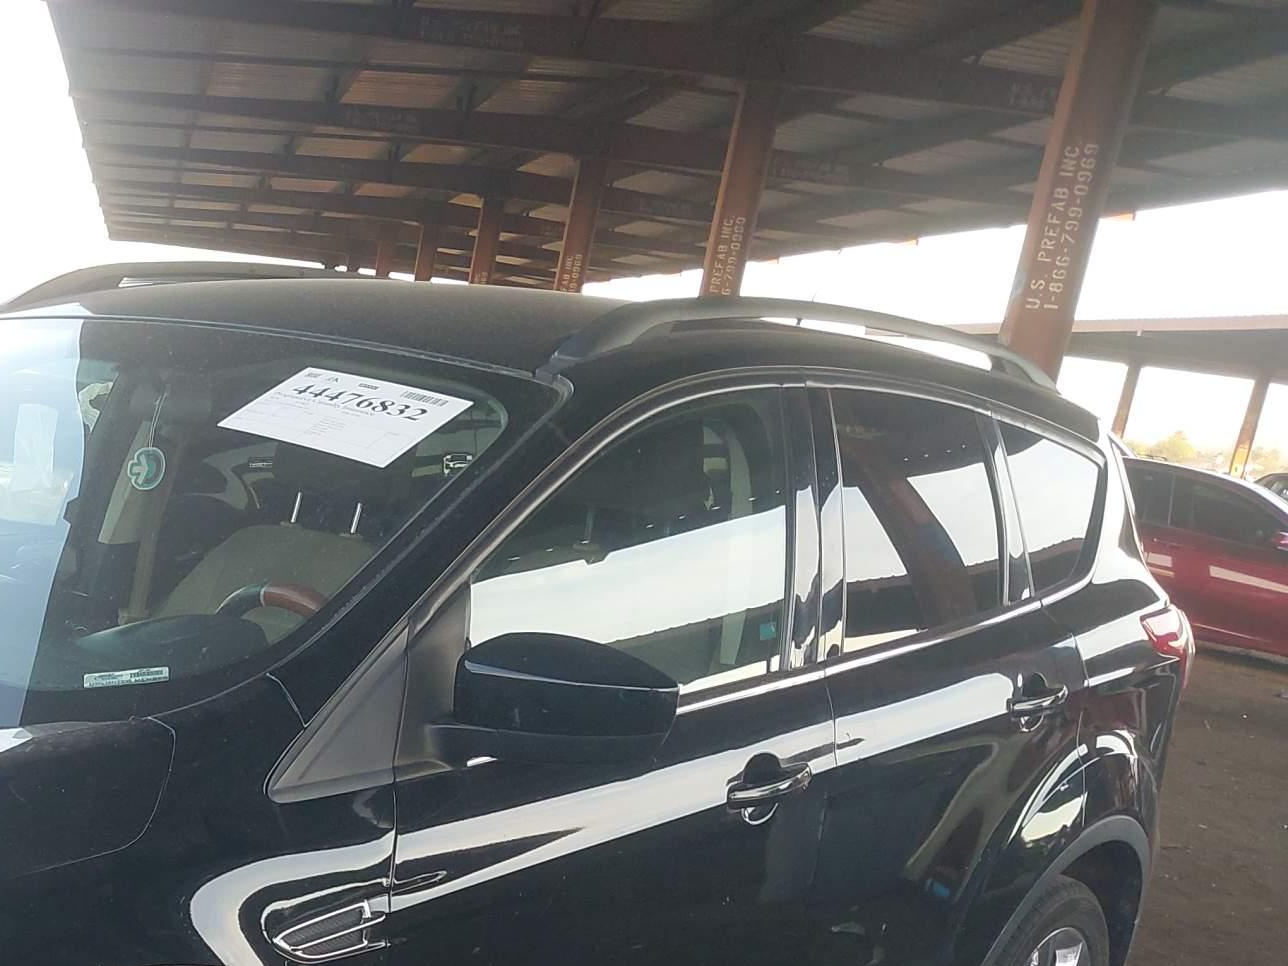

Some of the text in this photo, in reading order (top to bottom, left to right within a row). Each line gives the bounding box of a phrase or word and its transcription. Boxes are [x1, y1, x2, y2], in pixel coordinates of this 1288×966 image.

[1025, 274, 1048, 310] U.S.
[1037, 187, 1070, 262] PREFAB
[292, 384, 428, 421] 44476832
